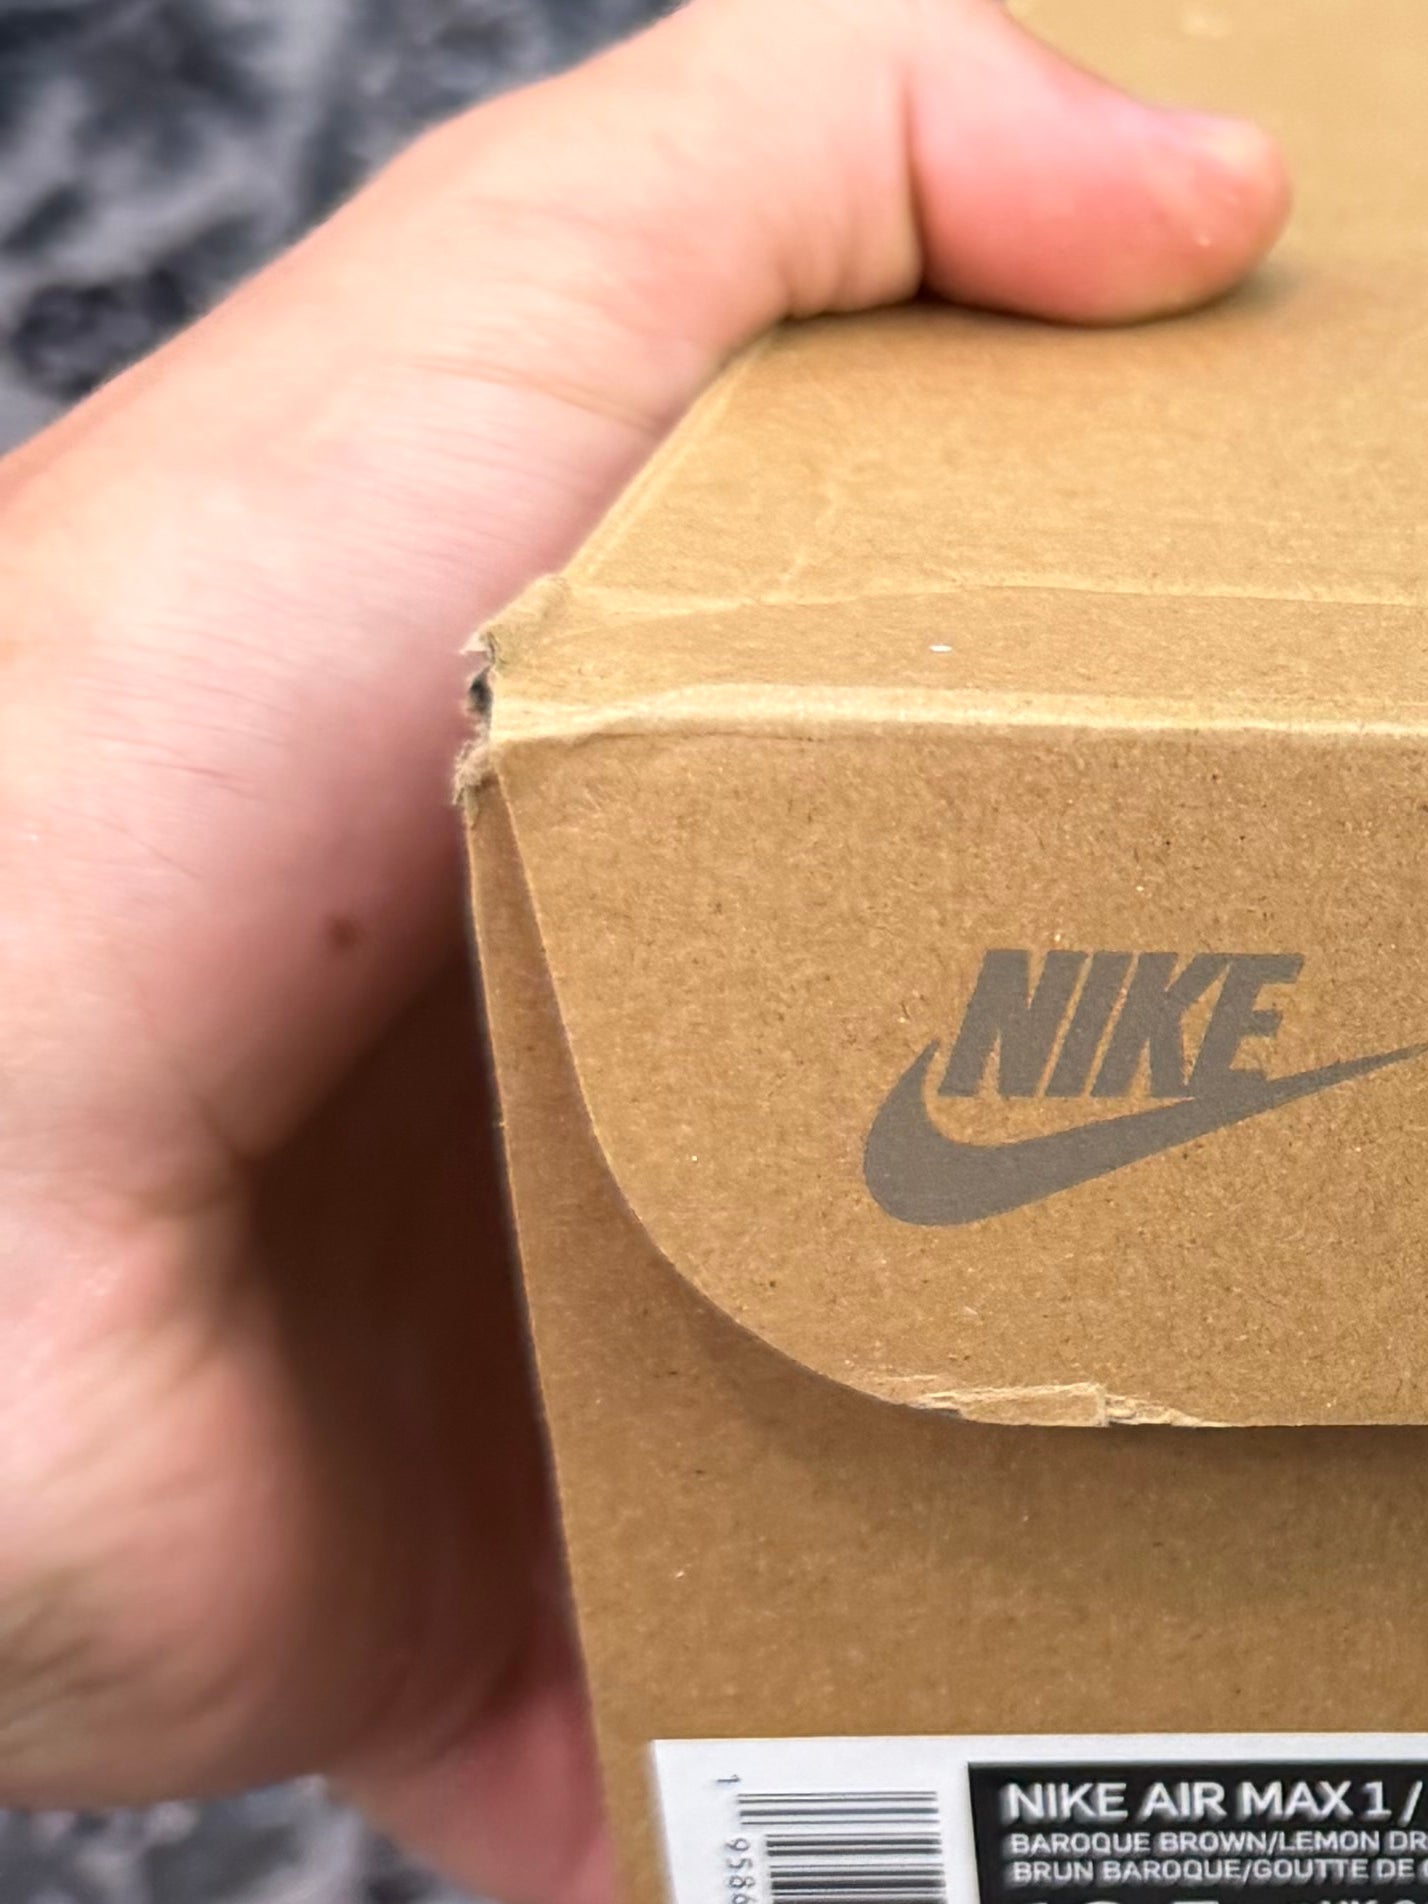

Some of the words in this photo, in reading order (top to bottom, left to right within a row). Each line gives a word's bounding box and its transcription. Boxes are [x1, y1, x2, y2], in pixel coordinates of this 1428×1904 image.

[937, 948, 1306, 1098] NIKE
[1002, 1782, 1128, 1822] NIKE
[1138, 1781, 1227, 1821] AIR
[1236, 1780, 1353, 1821] MAX
[1361, 1781, 1392, 1820] 1
[1005, 1832, 1151, 1855] BAROQUE
[1156, 1830, 1380, 1855] BROWN/LEMON
[1007, 1860, 1093, 1883] BRUN
[1099, 1858, 1369, 1883] BAROQUE/GOUTTE
[1375, 1857, 1415, 1882] DE
